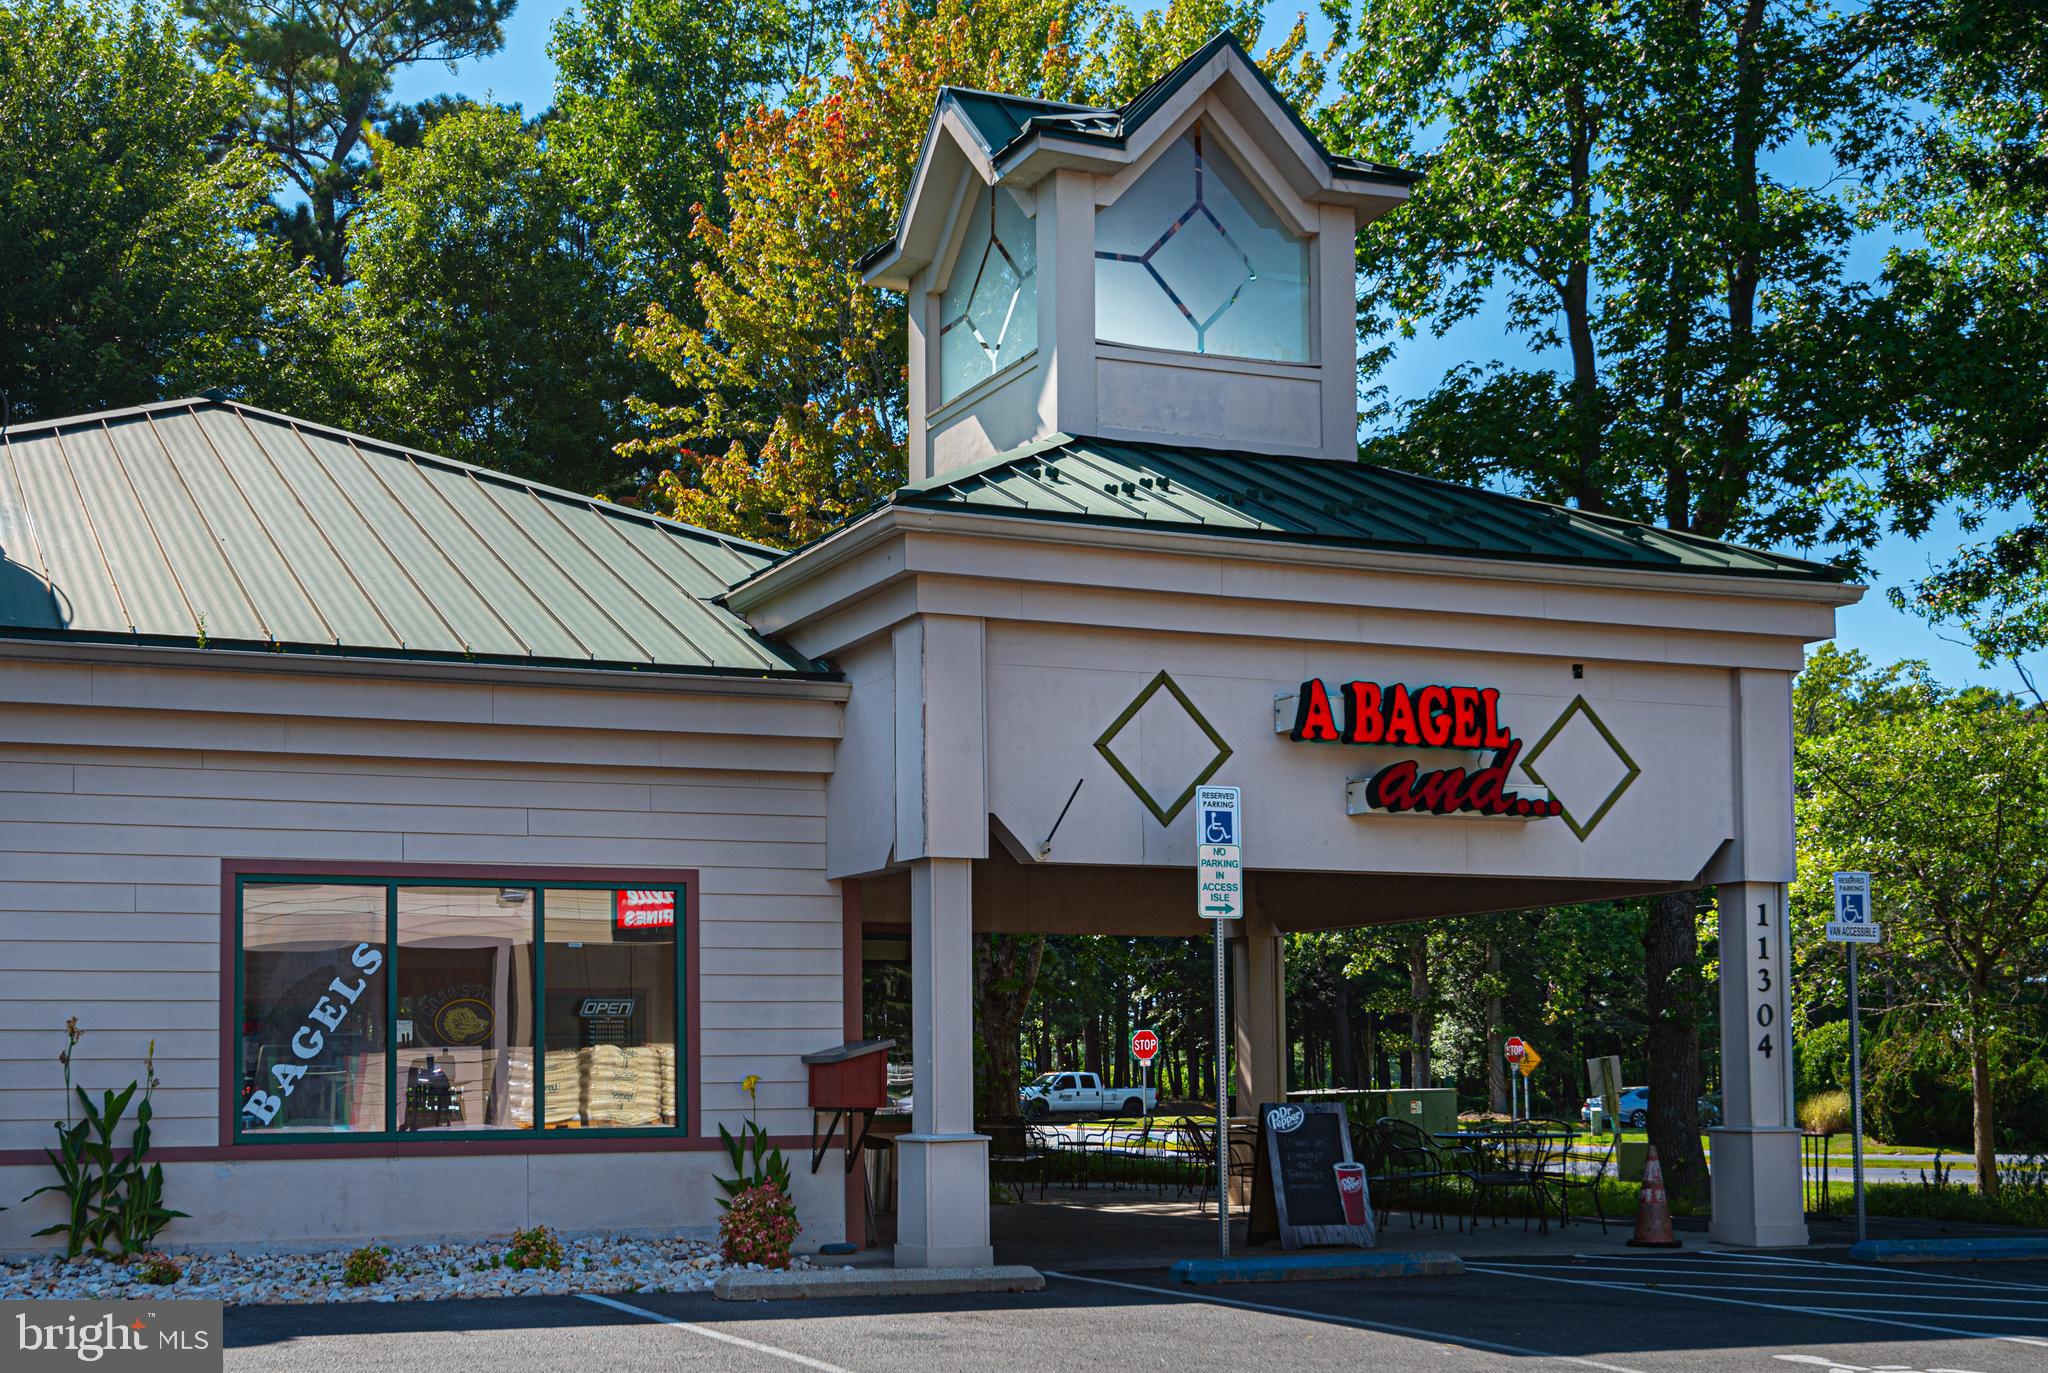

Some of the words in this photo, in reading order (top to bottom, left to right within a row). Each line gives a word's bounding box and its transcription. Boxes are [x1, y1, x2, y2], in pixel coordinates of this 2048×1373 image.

[1291, 678, 1339, 742] A
[1341, 680, 1511, 750] BAGEL
[1201, 791, 1235, 800] RESERVED
[1202, 800, 1234, 809] PARKING
[1212, 847, 1226, 856] NO
[1201, 859, 1239, 869] PARKING
[1215, 871, 1225, 880] IN
[1202, 882, 1239, 892] ACCESS
[1210, 893, 1230, 902] ISLE
[1829, 926, 1841, 936] VAN
[1842, 926, 1877, 937] ACCESSIBLE
[583, 1002, 631, 1014] OPEN
[241, 942, 383, 1126] BAGELS
[1134, 1039, 1157, 1051] STOP
[1506, 1045, 1523, 1056] STOP
[1278, 1106, 1293, 1118] Dr
[1270, 1109, 1301, 1130] Pepper
